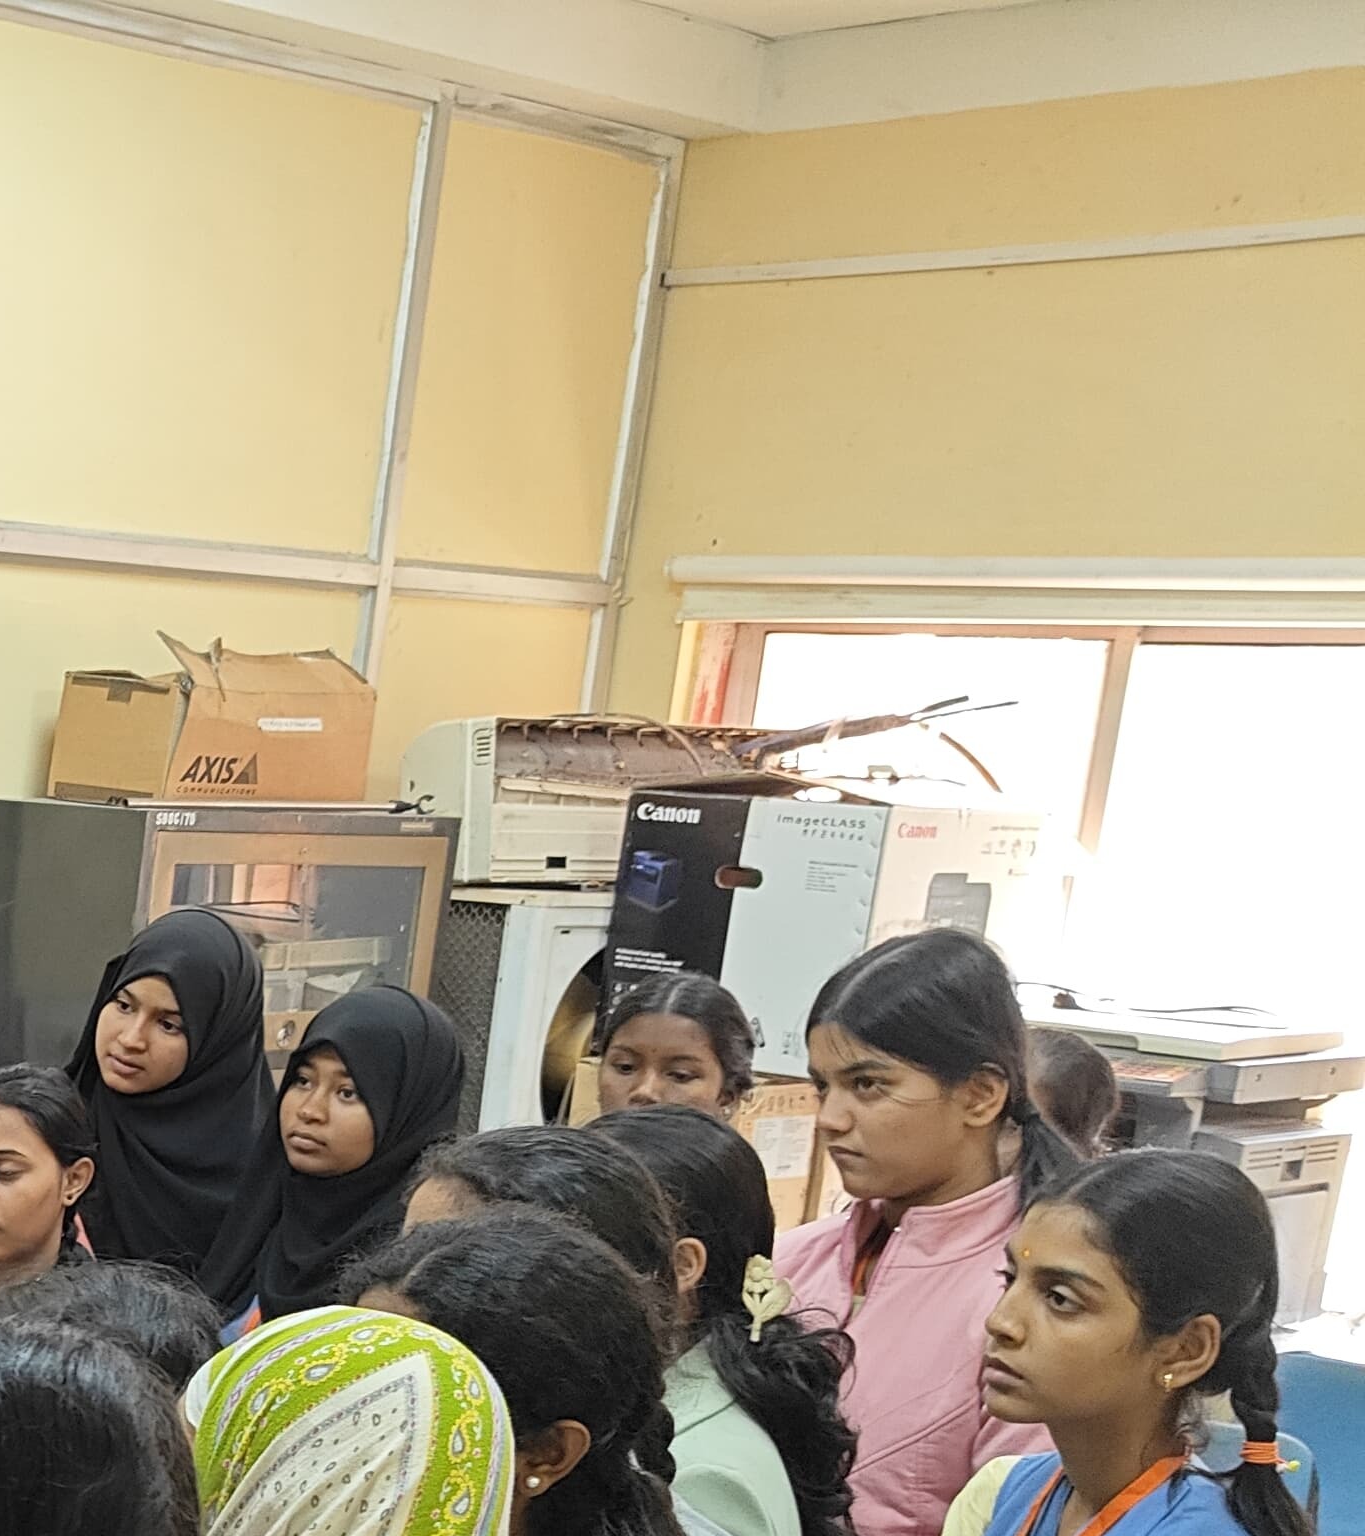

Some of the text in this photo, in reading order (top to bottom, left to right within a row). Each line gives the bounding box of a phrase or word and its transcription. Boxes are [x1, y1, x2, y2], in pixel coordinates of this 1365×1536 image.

[179, 755, 238, 784] AXIS
[176, 786, 257, 795] COMMUNICATIONS
[637, 803, 702, 824] Canon
[897, 823, 938, 839] Canon
